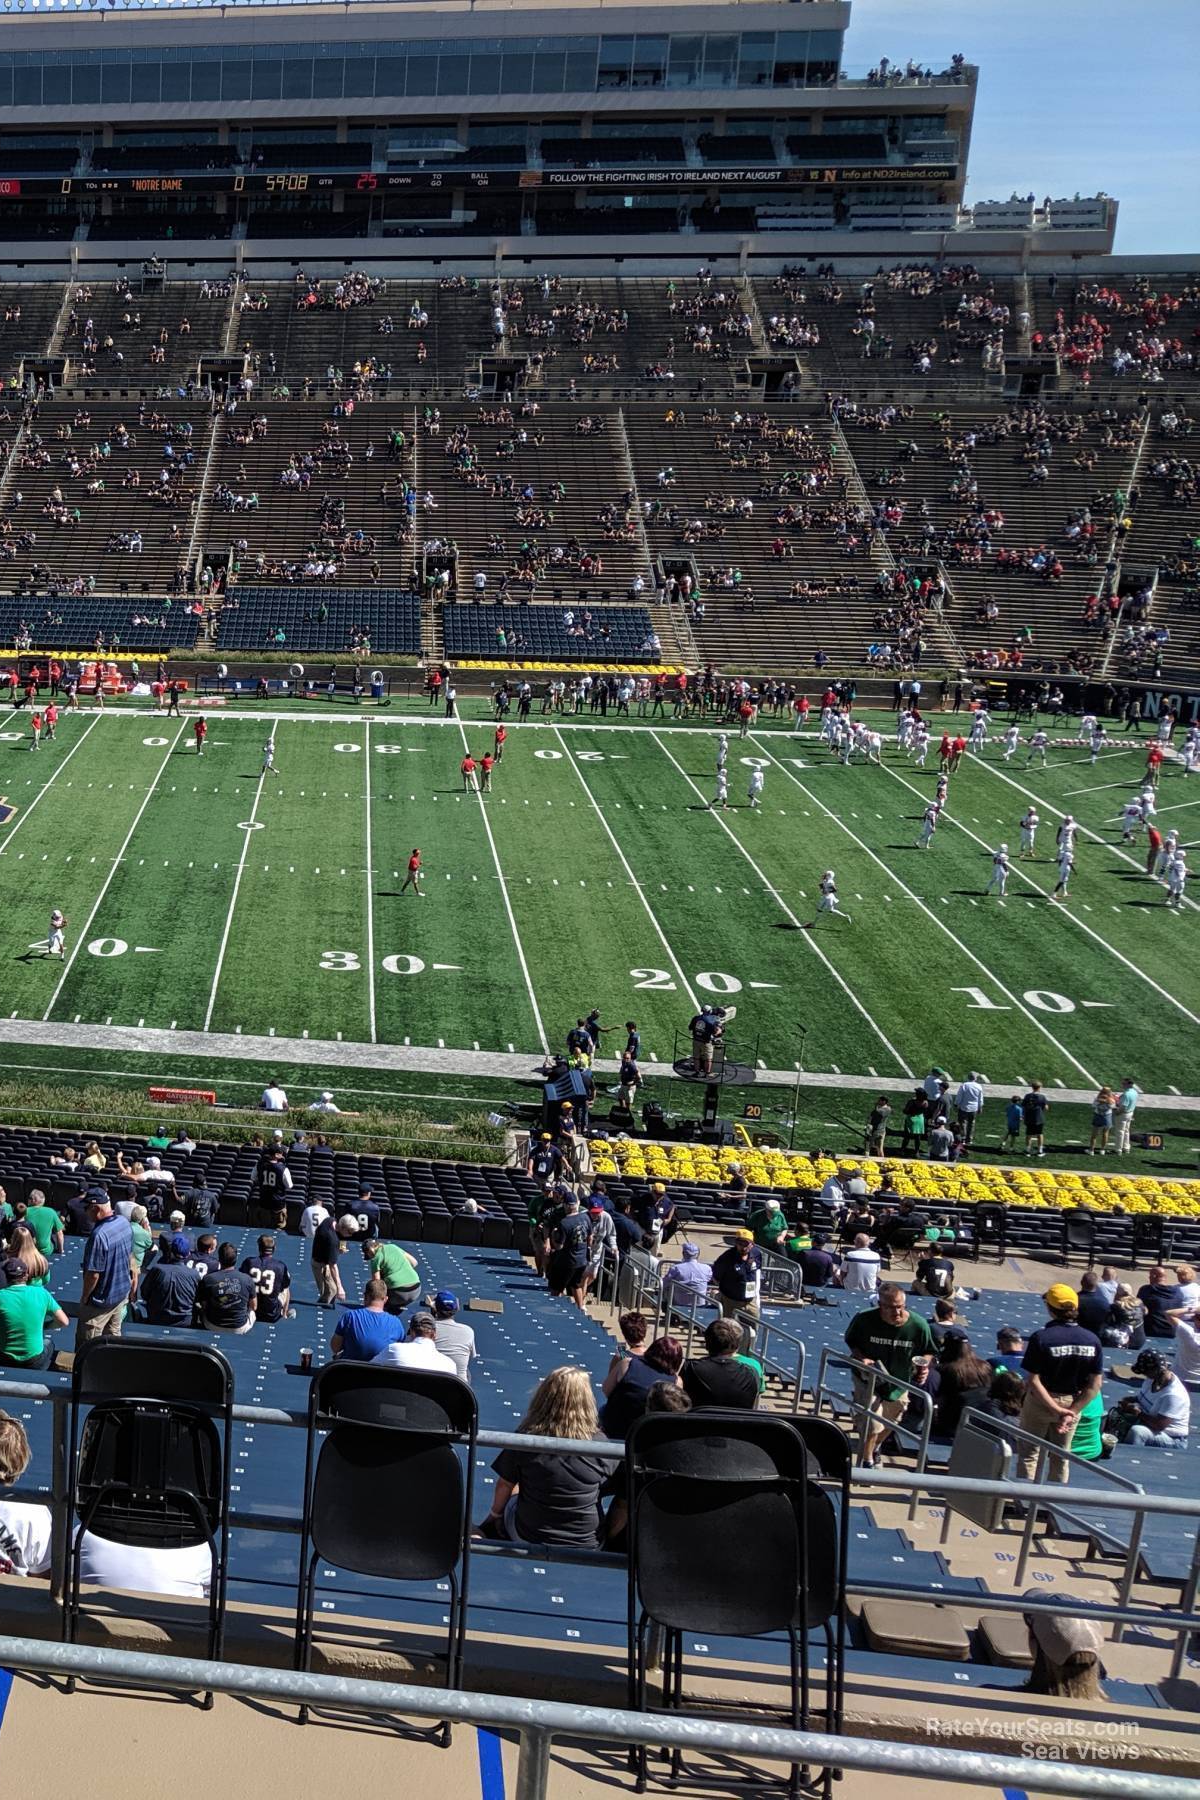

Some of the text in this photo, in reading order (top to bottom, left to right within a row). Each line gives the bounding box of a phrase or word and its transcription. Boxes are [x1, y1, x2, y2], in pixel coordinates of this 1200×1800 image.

[234, 176, 244, 190] 0
[266, 175, 308, 191] 59:08
[357, 174, 377, 190] 25
[550, 174, 586, 182] FOLLOW
[588, 173, 604, 182] THE
[605, 173, 646, 182] FIGHTING
[647, 172, 669, 181] IRISH
[670, 172, 682, 181] TO
[684, 172, 720, 181] IRELAND
[721, 172, 744, 180] NEXT
[745, 171, 782, 180] AUGUST
[842, 170, 860, 179] Info
[862, 170, 871, 179] at
[61, 179, 72, 194] 0
[136, 179, 160, 191] NOTRE
[162, 179, 182, 190] DAME
[746, 1104, 761, 1117] 20
[1148, 1136, 1161, 1147] 10
[262, 1169, 277, 1187] 18
[311, 1212, 320, 1227] 5
[249, 1267, 276, 1295] 23
[934, 1269, 948, 1287] 7
[869, 1336, 913, 1348] NOTRE DAME
[1050, 1345, 1096, 1357] USHER
